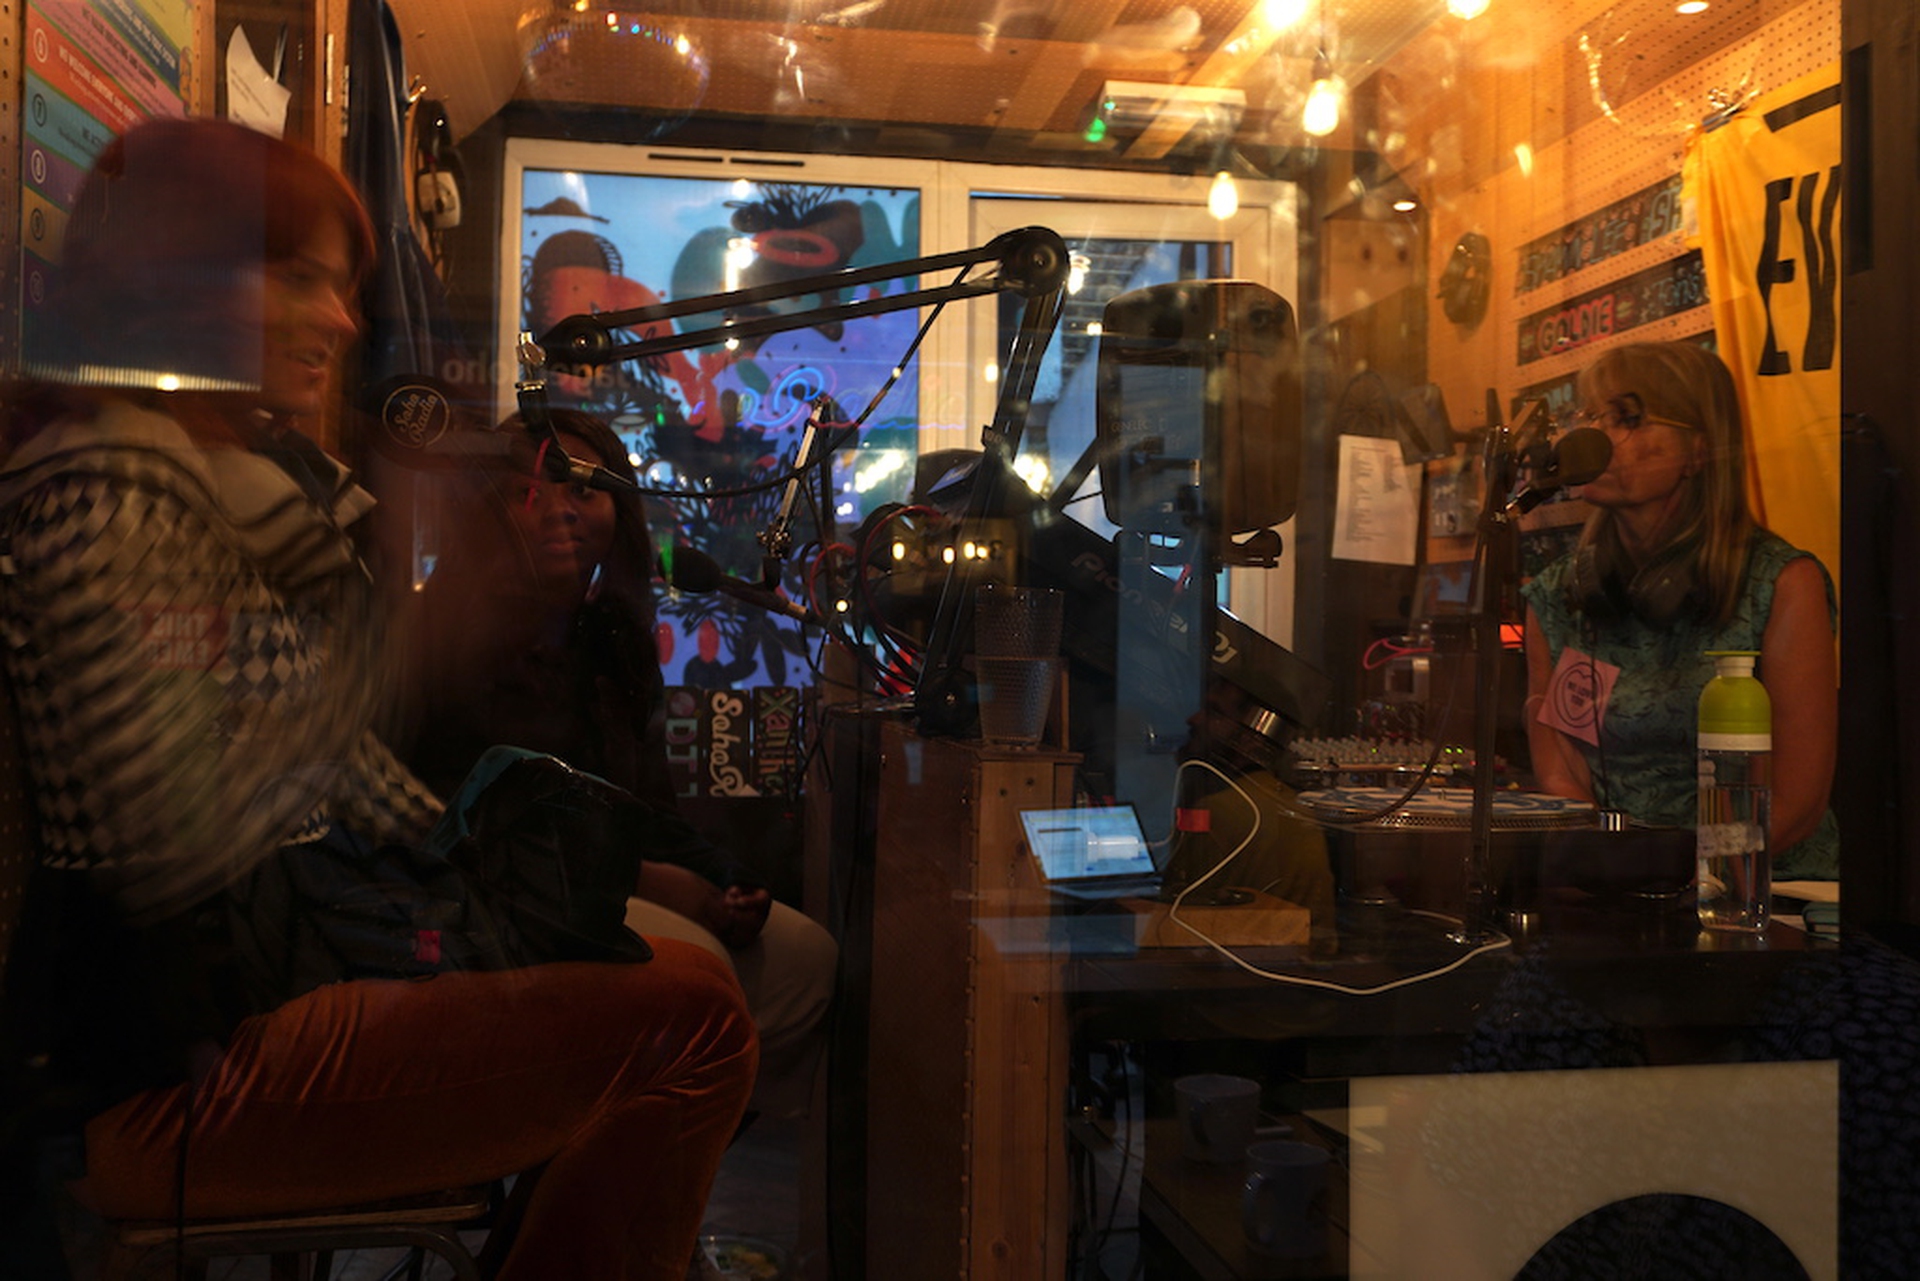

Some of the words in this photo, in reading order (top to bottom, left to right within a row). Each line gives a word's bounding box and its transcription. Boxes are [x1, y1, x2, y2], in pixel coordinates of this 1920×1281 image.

[1541, 298, 1613, 353] GOLDIE
[393, 392, 420, 433] Soho
[408, 392, 439, 445] Radio
